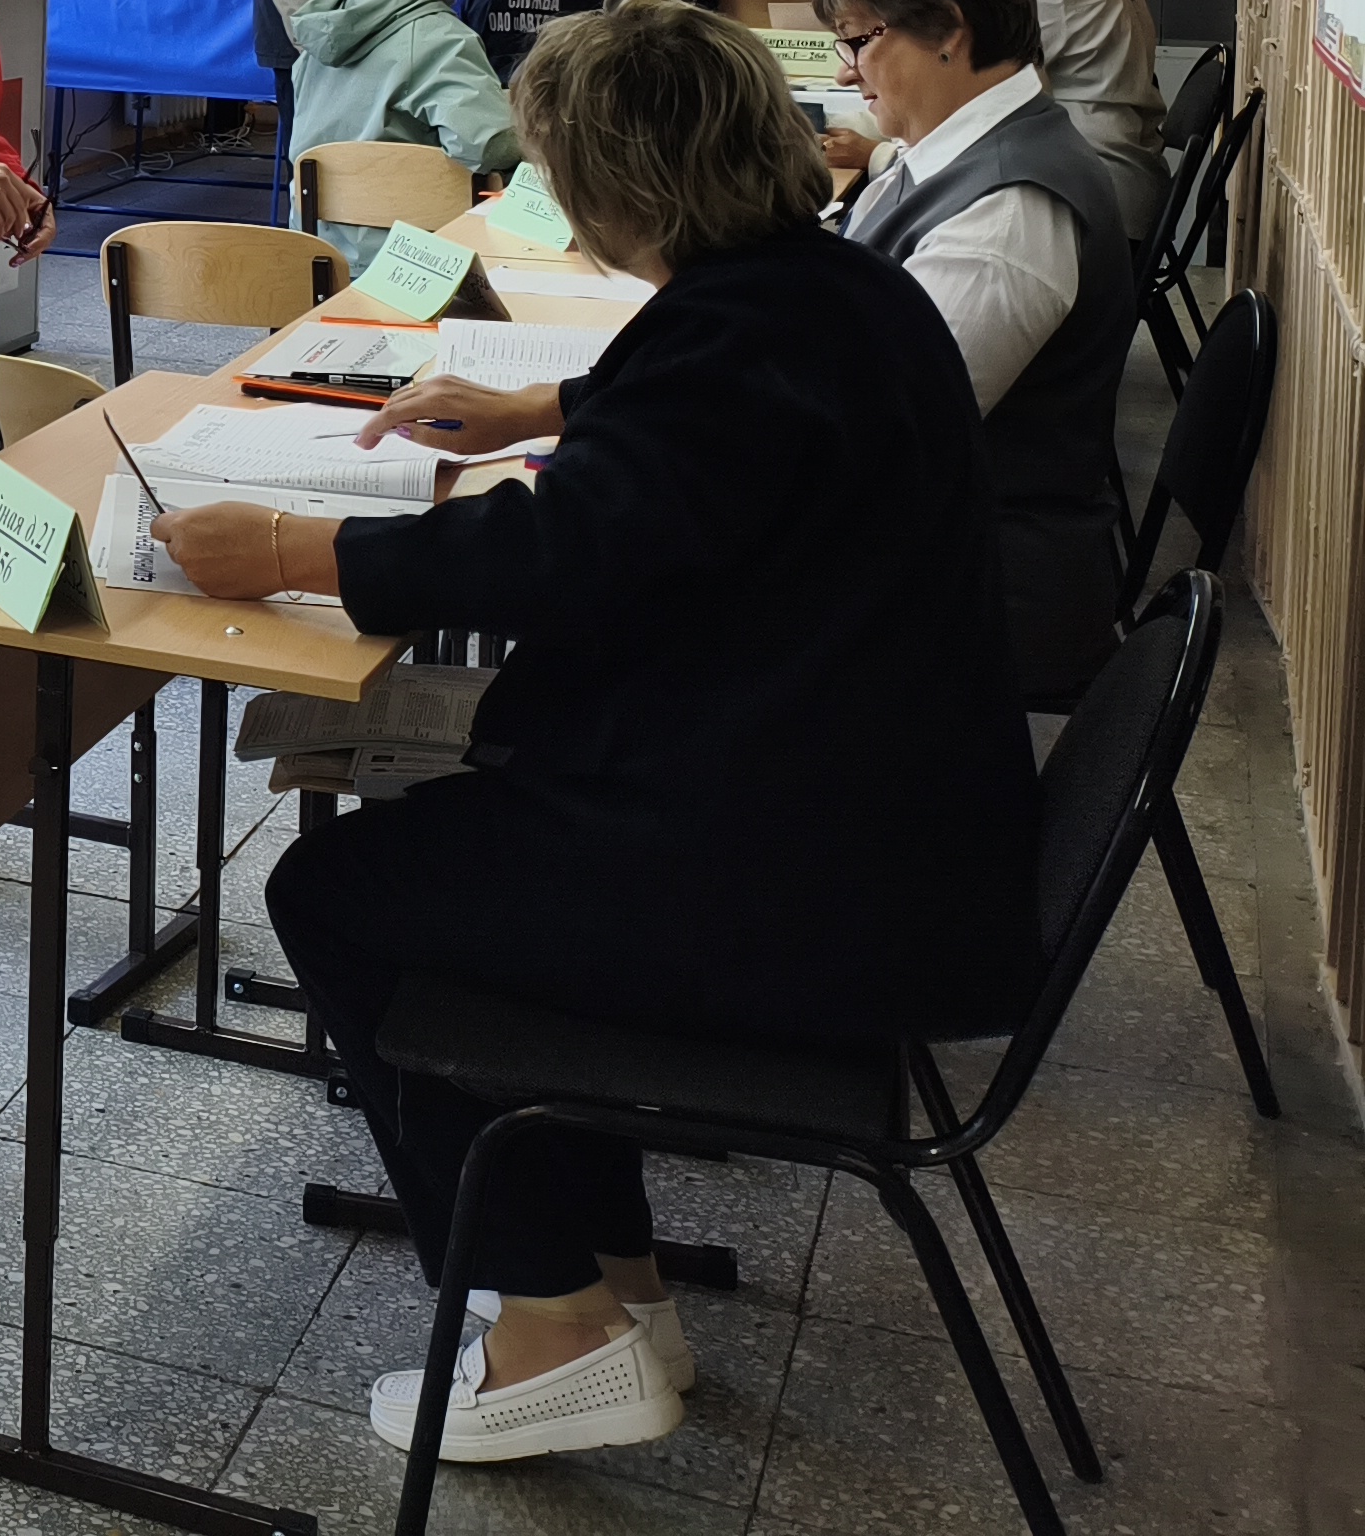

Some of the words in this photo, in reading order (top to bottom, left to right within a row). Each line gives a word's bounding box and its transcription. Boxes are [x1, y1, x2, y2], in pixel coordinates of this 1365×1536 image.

[488, 11, 511, 32] ОАО
[388, 233, 442, 269] Юбилейная
[24, 515, 56, 556] д.21
